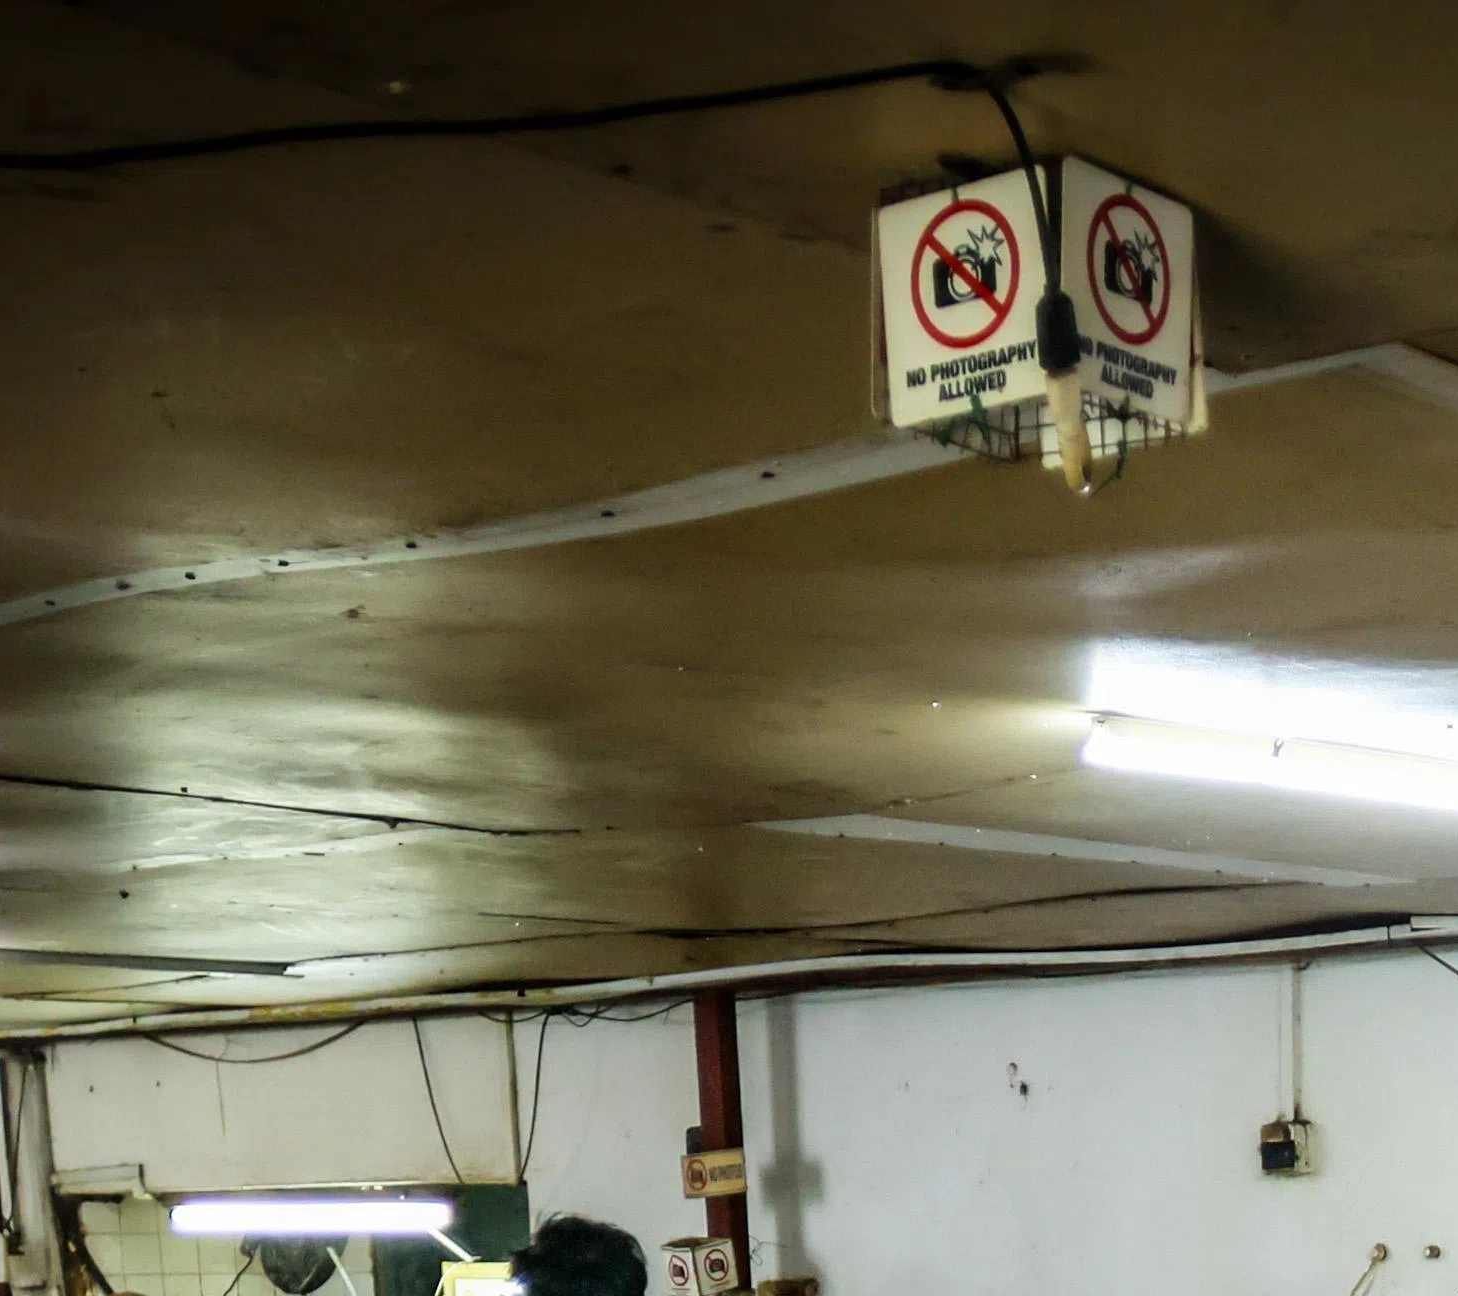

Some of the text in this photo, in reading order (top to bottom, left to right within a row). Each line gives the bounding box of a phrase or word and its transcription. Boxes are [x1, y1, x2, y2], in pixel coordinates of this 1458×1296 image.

[906, 339, 1036, 388] NO PHOTOGRAPHY
[1096, 341, 1177, 386] PHOTOGRAPHY
[1100, 363, 1154, 398] ALLOWED
[939, 370, 1006, 401] ALLOWED
